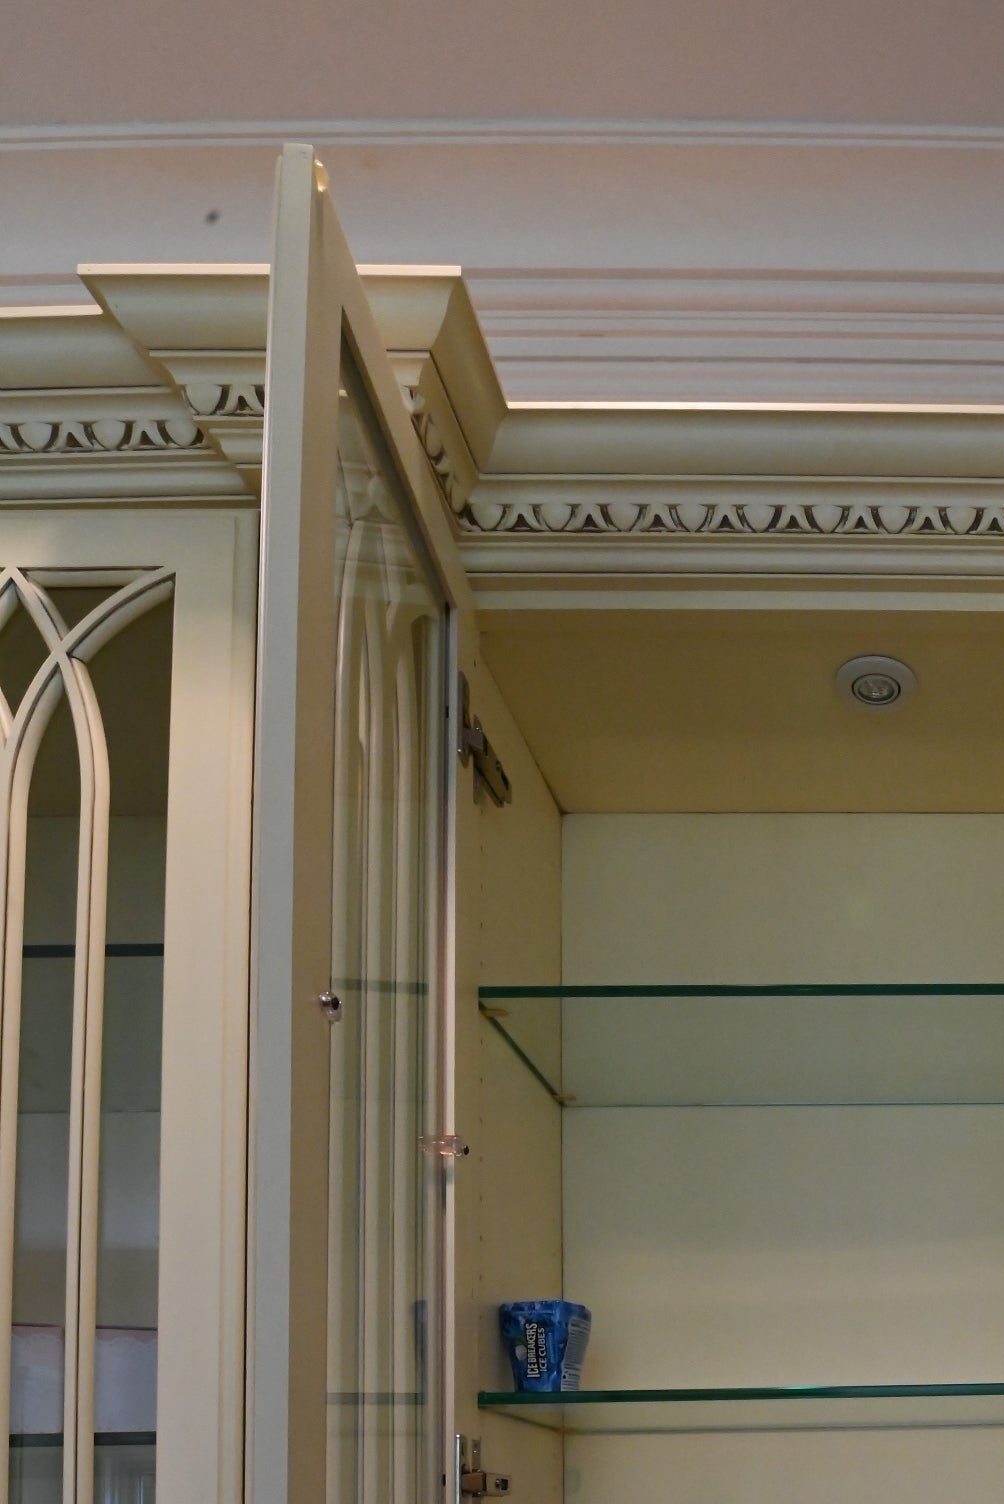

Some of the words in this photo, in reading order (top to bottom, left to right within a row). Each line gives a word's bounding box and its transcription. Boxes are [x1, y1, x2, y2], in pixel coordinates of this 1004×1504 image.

[525, 1323, 538, 1364] BREAKERS
[537, 1327, 546, 1356] CUBES
[526, 1365, 540, 1378] ICE
[538, 1356, 548, 1372] ICE
